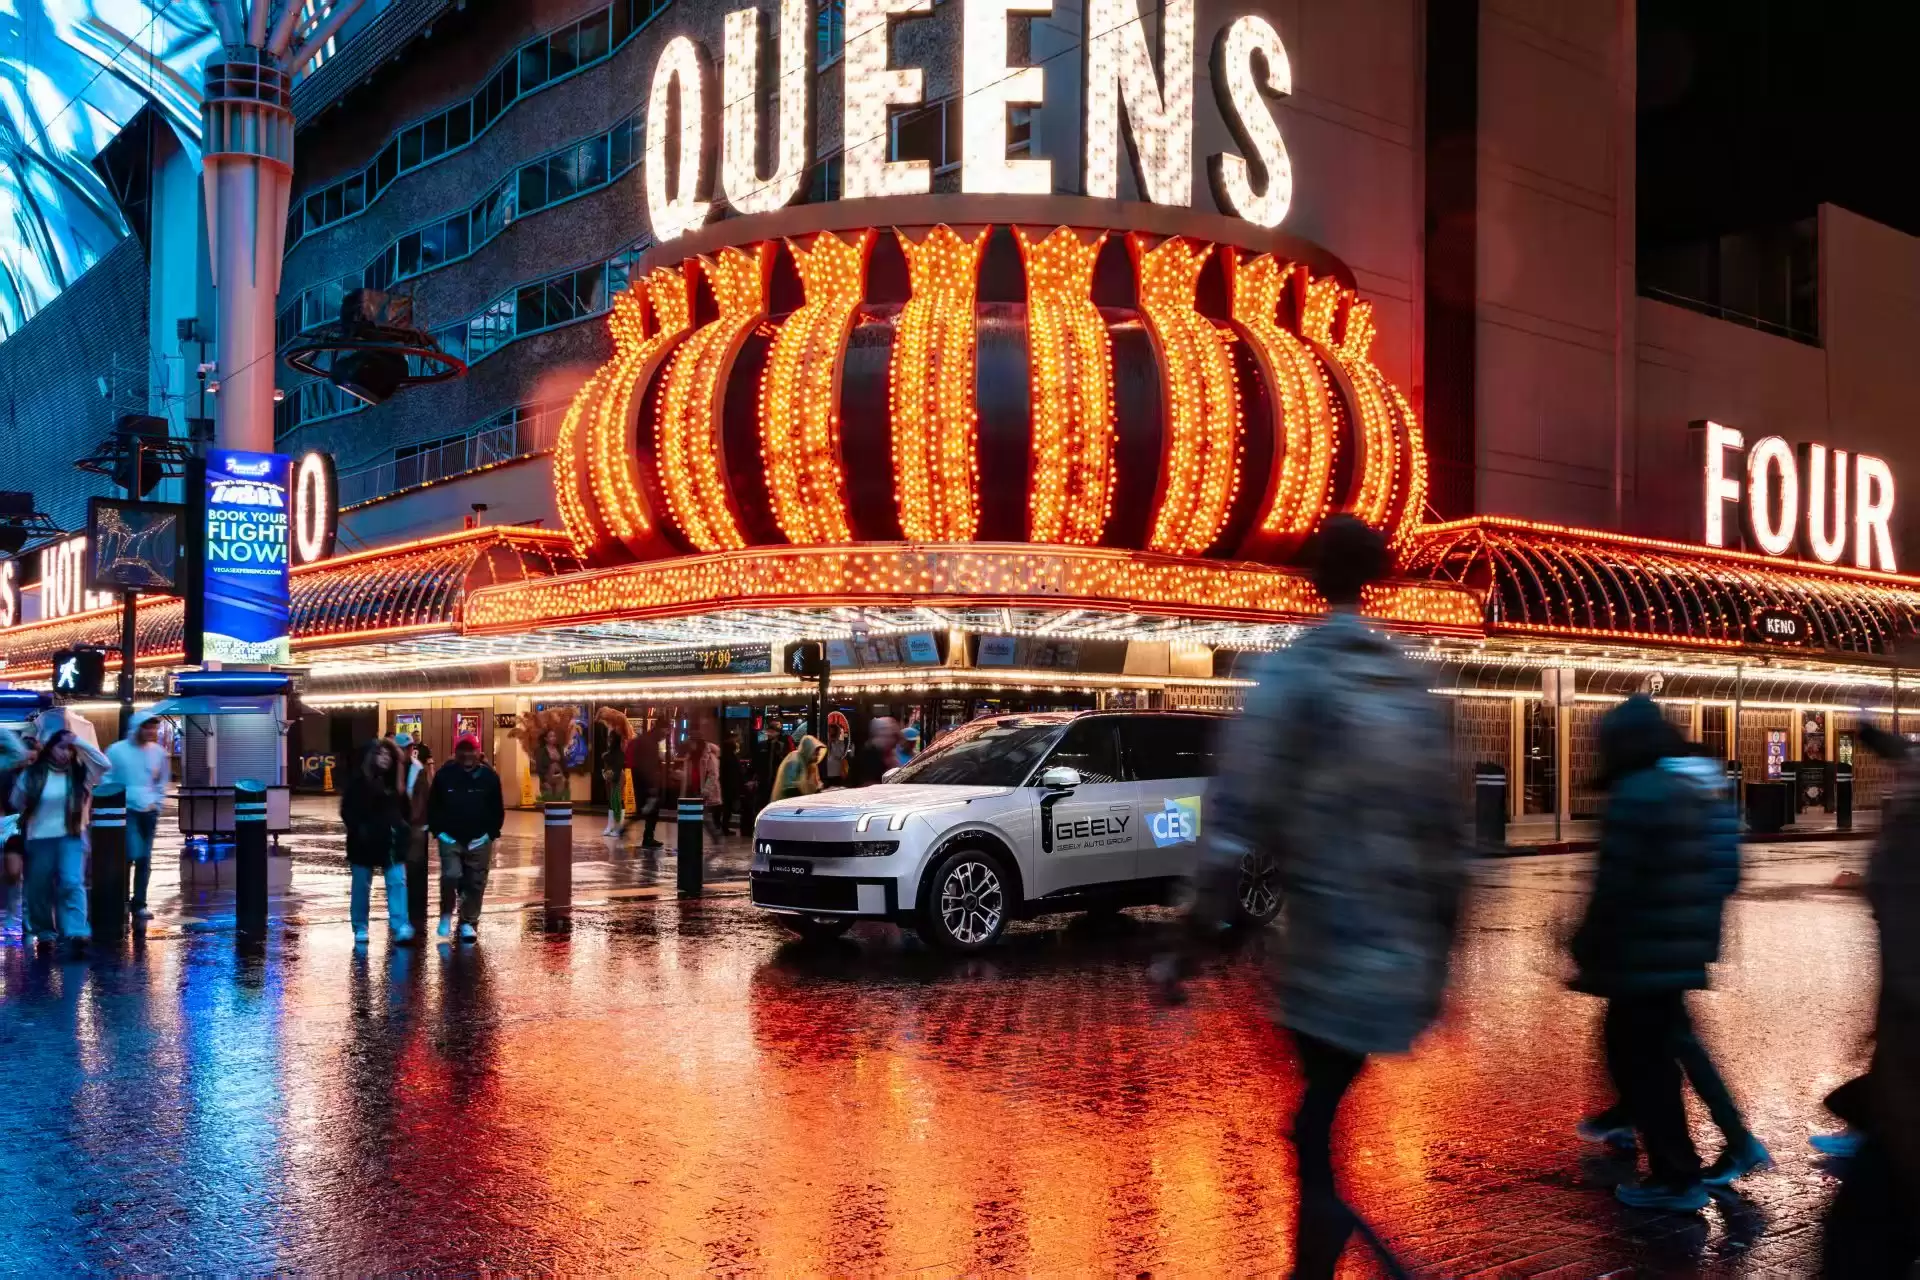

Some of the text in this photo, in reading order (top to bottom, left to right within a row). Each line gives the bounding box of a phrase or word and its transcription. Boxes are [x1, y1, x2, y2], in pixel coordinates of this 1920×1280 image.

[645, 0, 1293, 242] QUEENS
[1705, 420, 1897, 573] FOUR
[208, 509, 287, 524] BOOK YOUR
[208, 521, 287, 542] FLIGHT
[208, 541, 287, 564] NOW!
[1766, 618, 1796, 634] KENO
[590, 659, 602, 672] Rib
[603, 660, 627, 672] Dinner
[1056, 816, 1130, 840] GEELY
[1153, 812, 1192, 839] CES
[1057, 836, 1133, 851] GEELY AUTO GROUP
